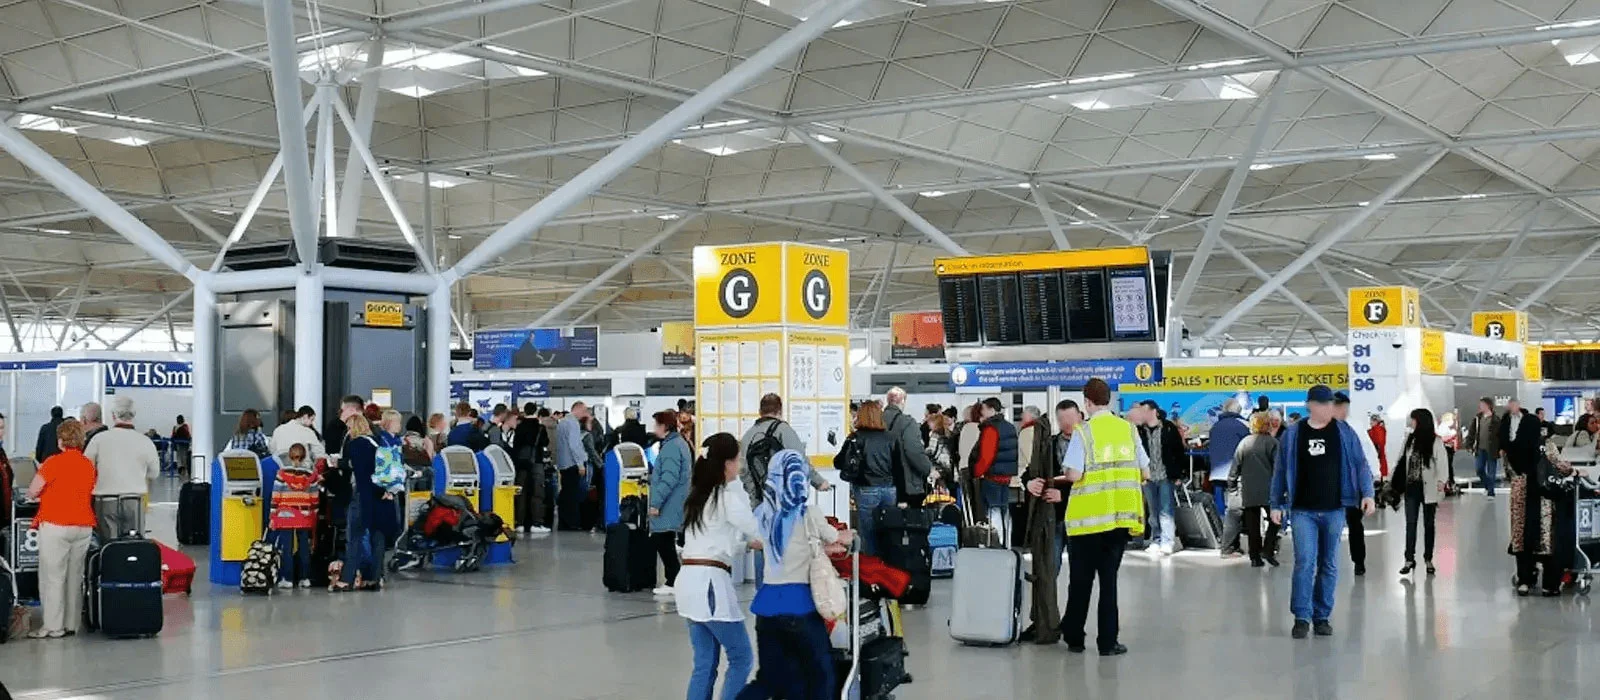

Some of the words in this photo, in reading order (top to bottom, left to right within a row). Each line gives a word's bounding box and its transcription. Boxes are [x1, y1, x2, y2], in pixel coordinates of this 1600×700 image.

[721, 252, 756, 265] ZONE
[804, 253, 830, 267] ZONE
[725, 275, 752, 311] G
[806, 276, 826, 312] G
[1368, 302, 1384, 321] F
[1488, 323, 1502, 339] E
[1353, 344, 1371, 357] 81
[1353, 361, 1371, 374] to
[1171, 375, 1202, 387] SALES
[1213, 375, 1249, 386] TICKET
[1252, 374, 1285, 385] SALES
[1298, 373, 1333, 385] TICKET
[1353, 379, 1375, 391] 96
